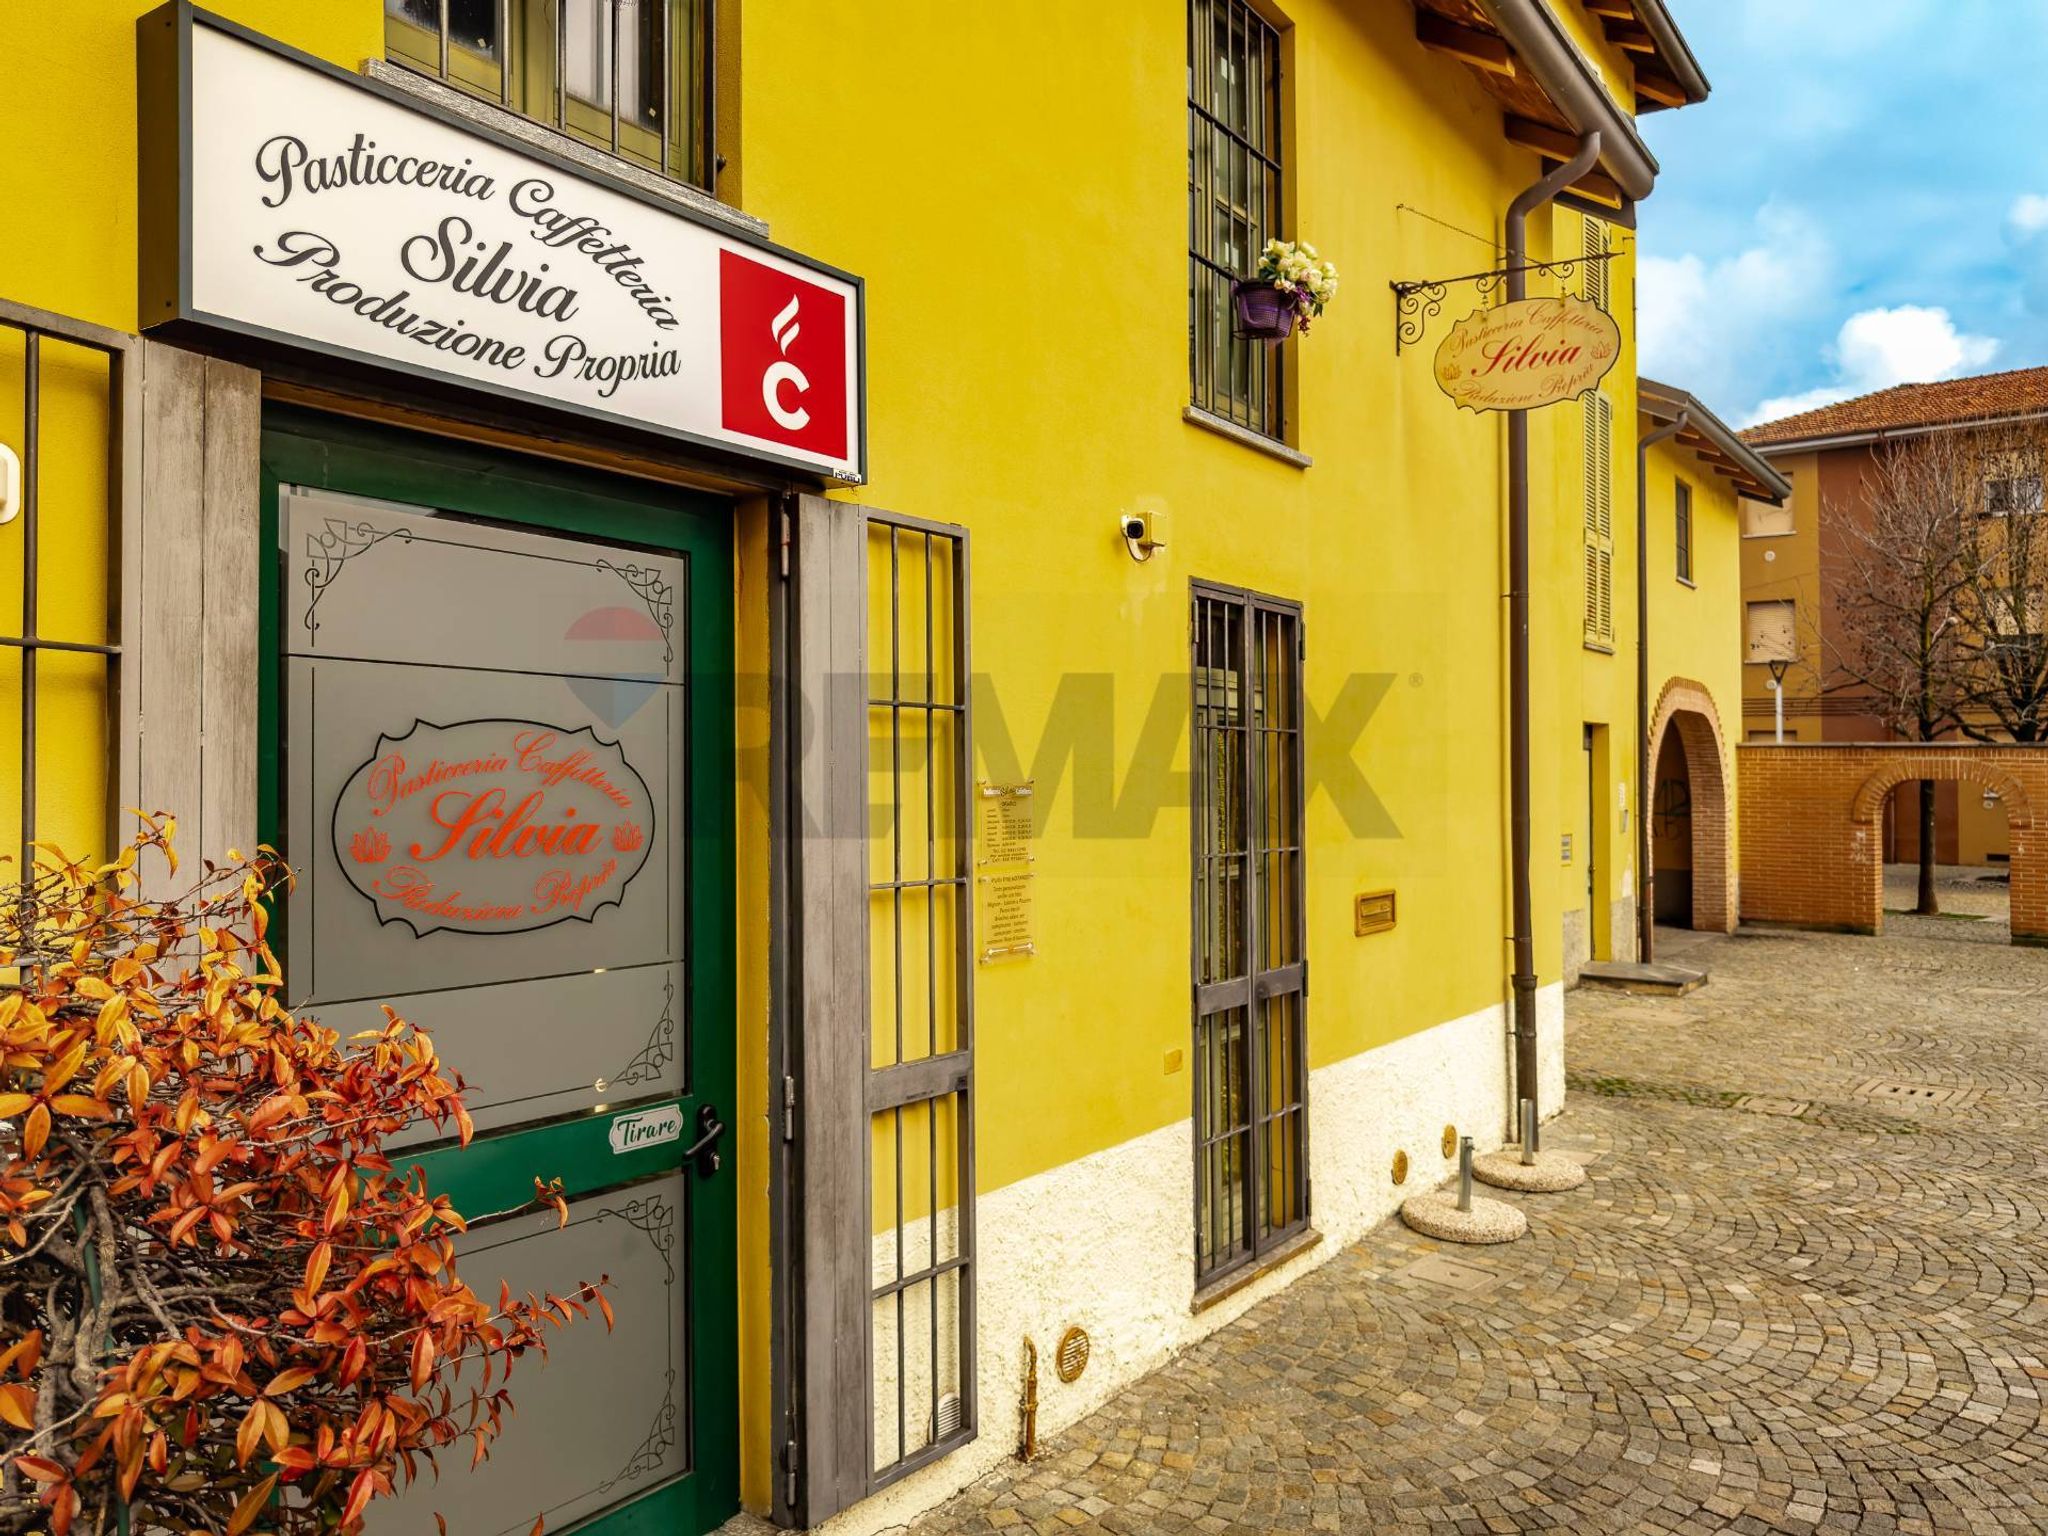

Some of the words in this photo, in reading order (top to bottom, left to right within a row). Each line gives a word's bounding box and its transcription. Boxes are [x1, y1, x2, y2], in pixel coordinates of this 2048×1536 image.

[256, 134, 496, 208] Pasticceria
[509, 180, 680, 331] Caffetteria
[401, 217, 580, 323] Silvia
[253, 232, 526, 370] Produzione
[534, 341, 682, 399] Propria
[1471, 333, 1582, 378] Silvia
[367, 750, 510, 817] Pasticceria
[512, 730, 633, 810] Caffetteria
[408, 786, 604, 864] Silvia
[371, 864, 524, 922] Produzione
[530, 858, 618, 915] Propria
[617, 1117, 678, 1146] Tirare
